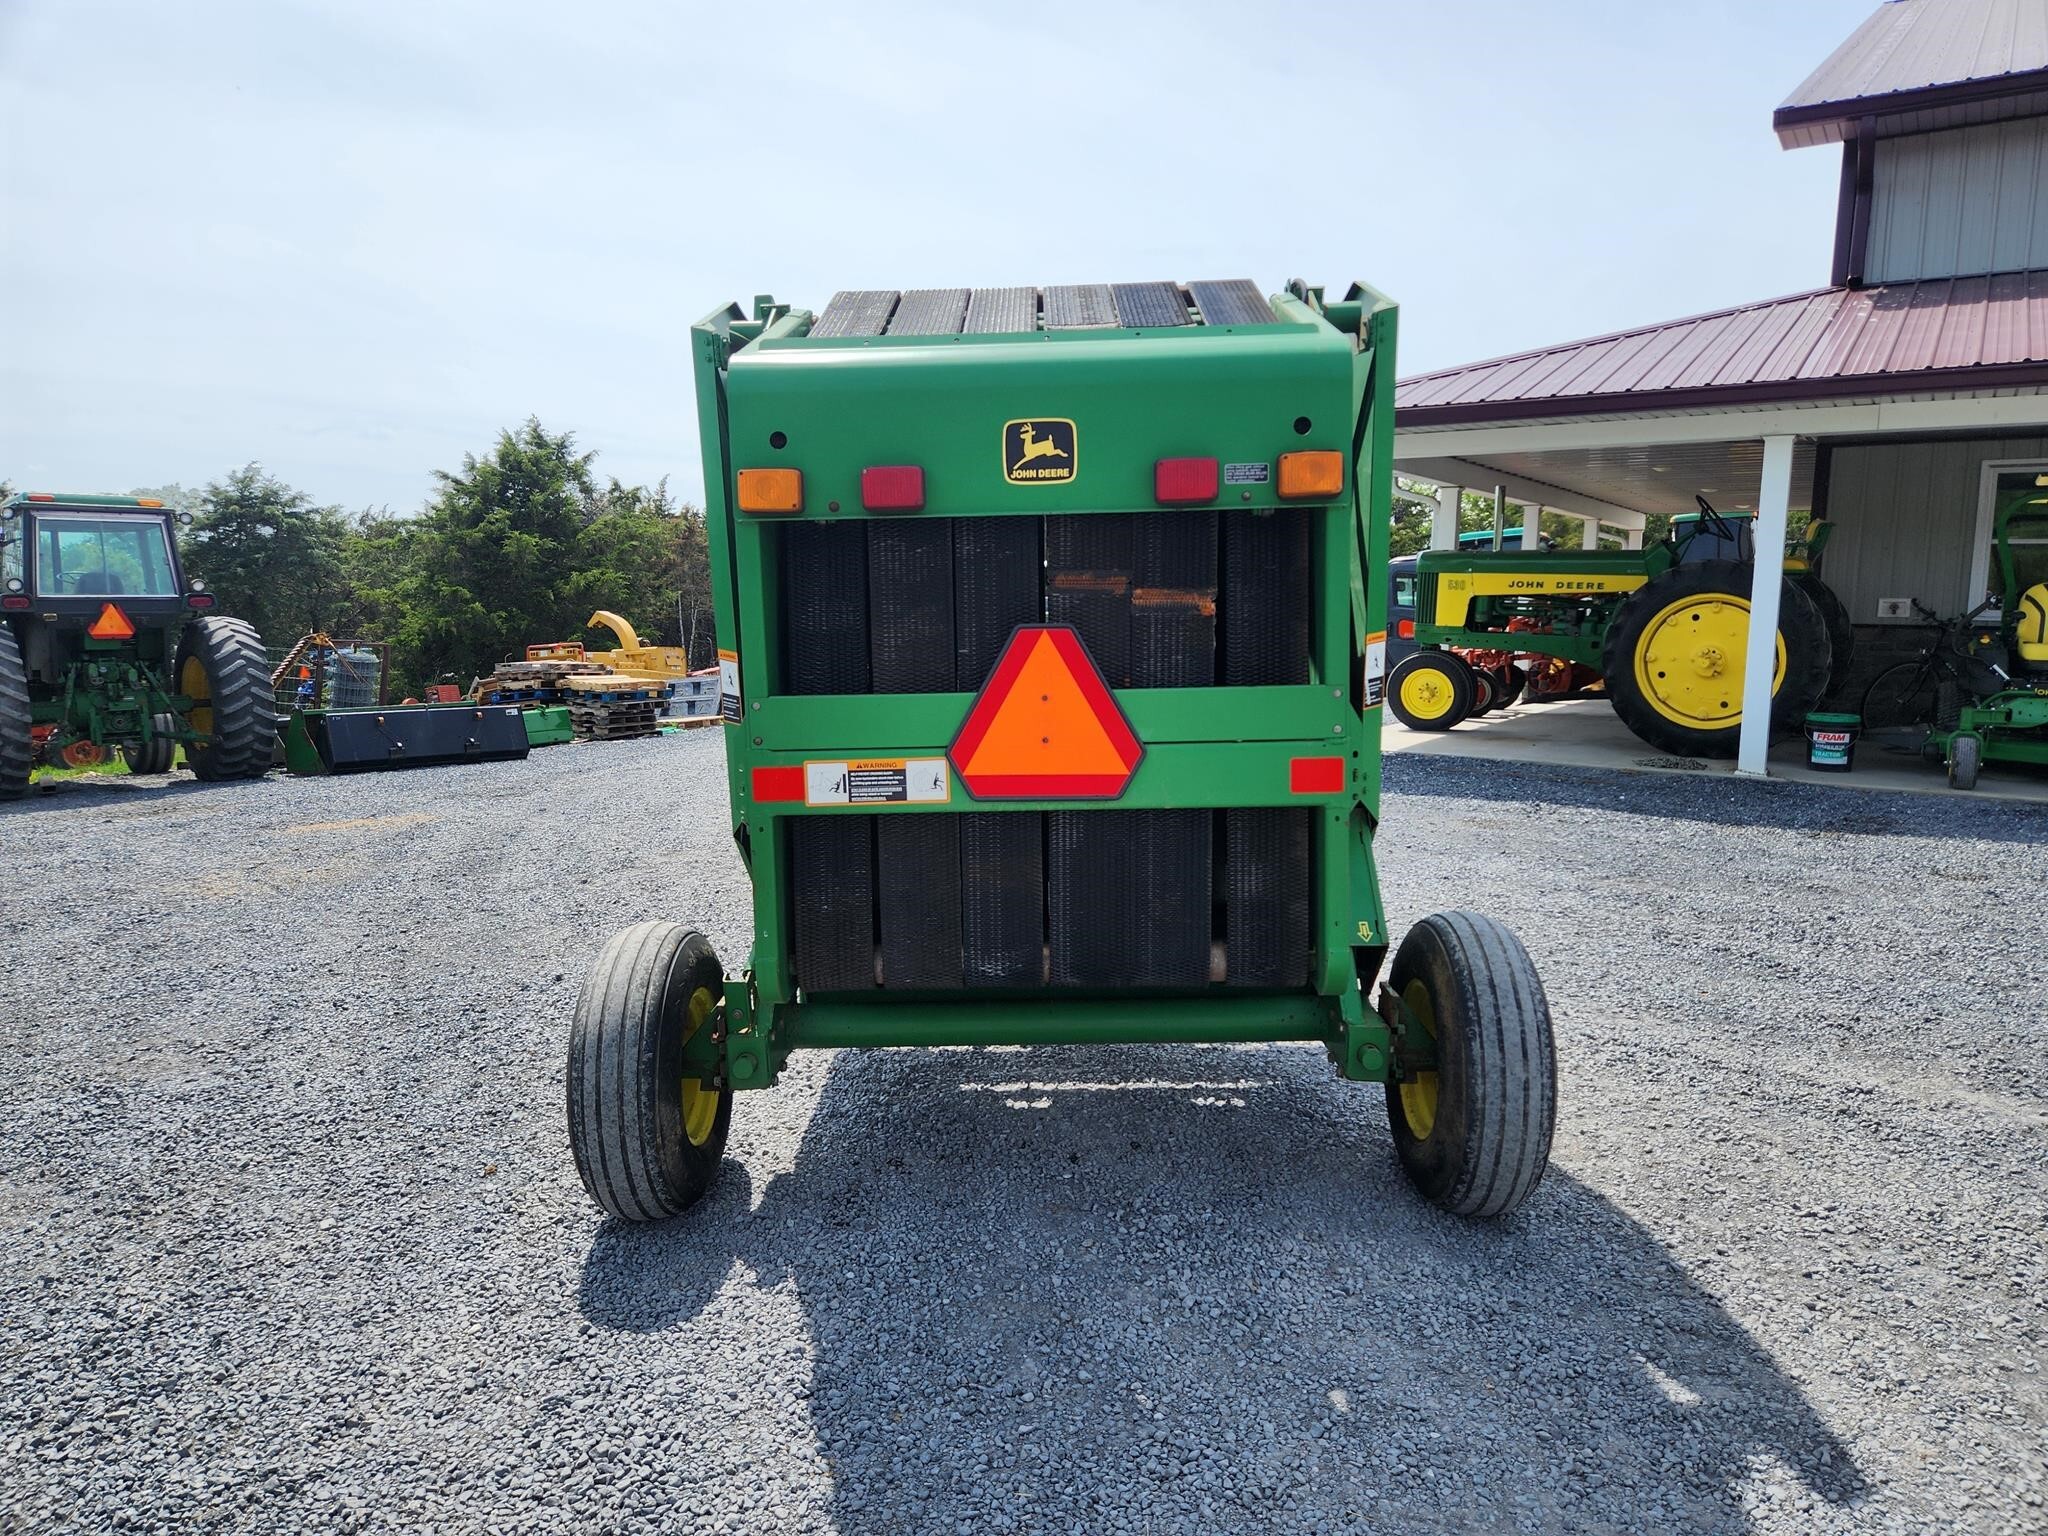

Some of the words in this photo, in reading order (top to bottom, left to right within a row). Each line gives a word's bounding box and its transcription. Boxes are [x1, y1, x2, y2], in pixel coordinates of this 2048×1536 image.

[1010, 469, 1037, 479] JOHN
[1038, 468, 1070, 478] DEERE
[1508, 580, 1545, 589] JOHN
[1556, 581, 1605, 590] DEERE
[1817, 733, 1846, 742] FRAM
[862, 761, 897, 769] WARNING
